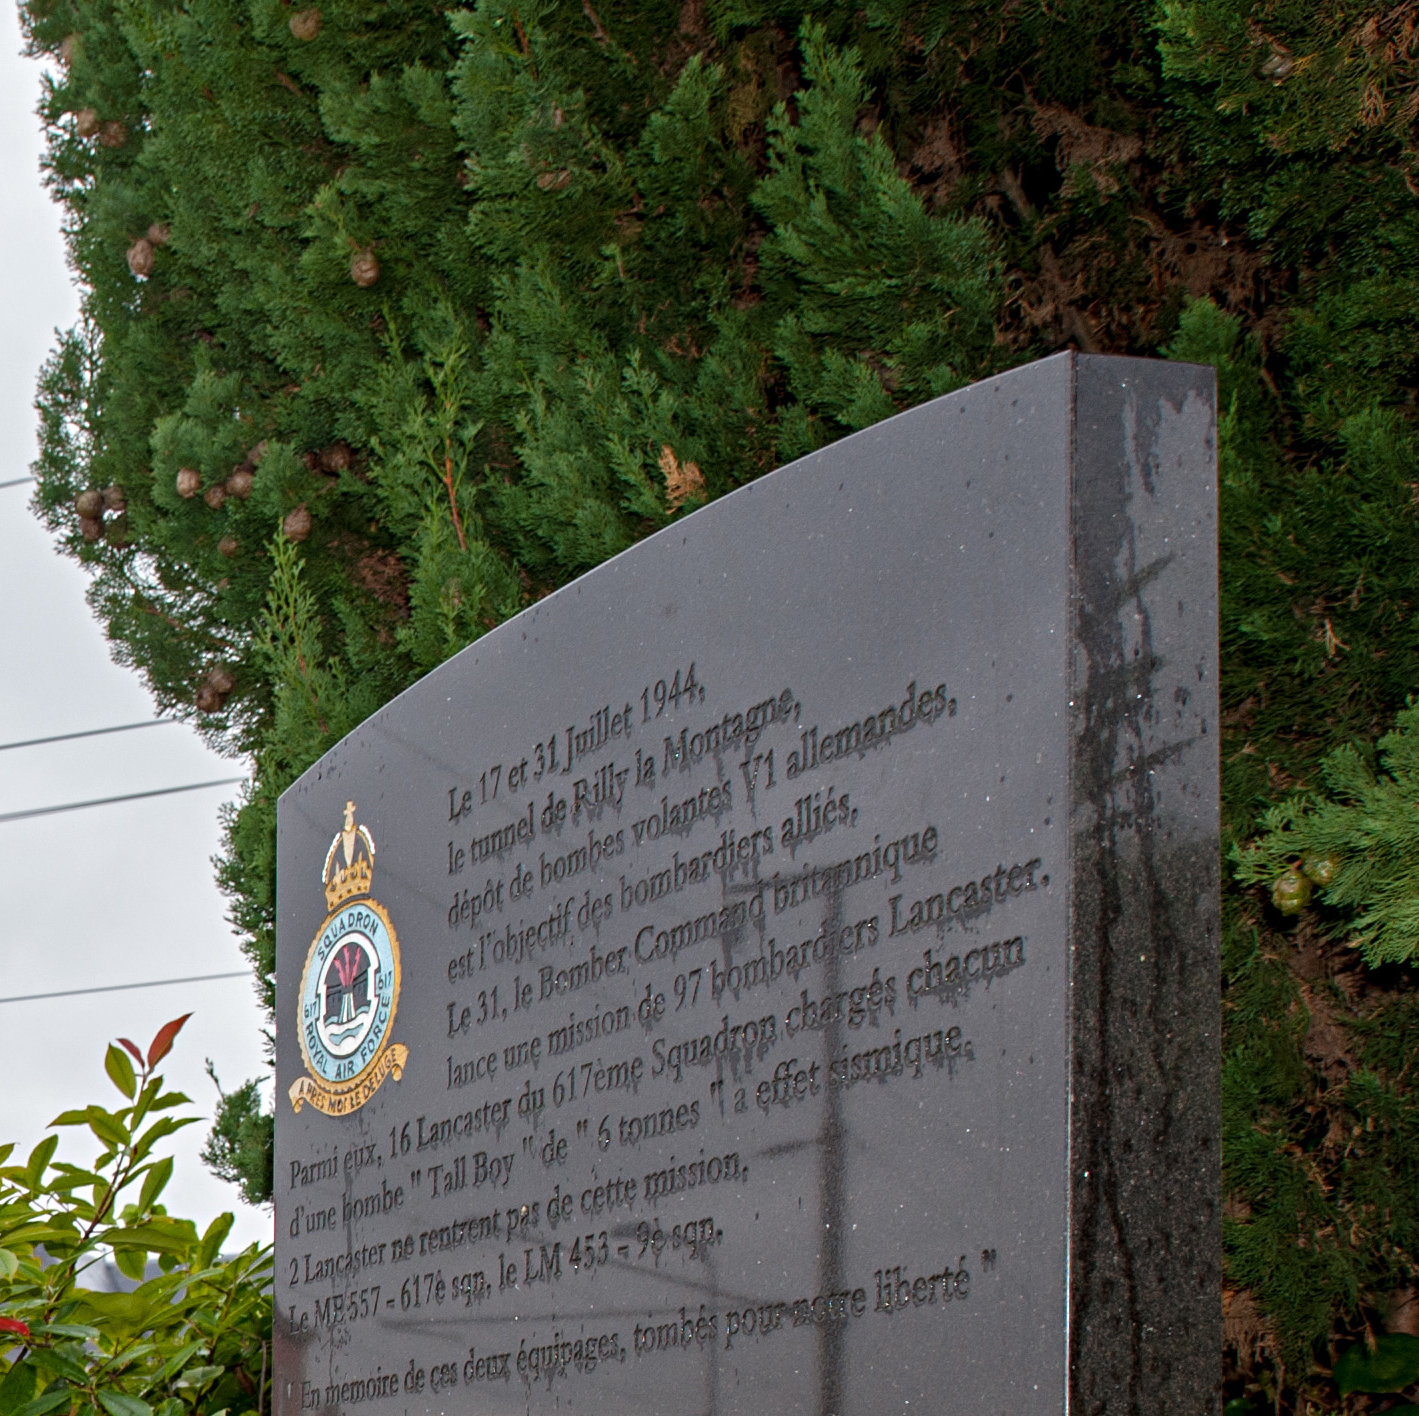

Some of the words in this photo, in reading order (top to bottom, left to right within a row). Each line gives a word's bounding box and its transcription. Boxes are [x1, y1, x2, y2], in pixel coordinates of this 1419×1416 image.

[448, 787, 472, 822] Le
[479, 765, 503, 805] 17
[508, 757, 528, 791] et
[533, 733, 559, 780] 31
[562, 703, 633, 776] Juillet
[640, 661, 706, 724] 1944,
[448, 841, 465, 875] le
[471, 802, 537, 865] tunnel
[541, 791, 567, 834] de
[573, 763, 630, 814] Rilly
[635, 748, 656, 786] la
[662, 687, 801, 774] Montagne,
[448, 878, 504, 930] dépôt
[510, 863, 534, 900] de
[539, 829, 625, 889] bombes
[631, 780, 732, 848] volantes
[739, 748, 775, 790] V1
[786, 680, 957, 780] allemandes,
[317, 912, 379, 961] SQUADRON
[447, 1001, 472, 1038] Le
[477, 984, 508, 1025] 31,
[514, 976, 533, 1011] le
[634, 881, 765, 965] Command
[774, 826, 938, 914] britannique
[448, 947, 474, 984] est
[479, 896, 575, 971] l'objectif
[577, 889, 612, 930] des
[619, 825, 773, 913] bombardiers
[781, 786, 858, 848] alliés,
[304, 1000, 317, 1019] 617
[305, 1022, 328, 1075] ROYAL
[334, 1060, 355, 1080] AIR
[361, 996, 390, 1064] FORCE
[378, 970, 393, 990] 617
[447, 1052, 497, 1090] lance
[503, 1036, 541, 1067] une
[548, 1004, 630, 1056] mission
[638, 984, 665, 1023] de
[673, 968, 703, 1013] 97
[710, 916, 880, 1002] bombardiers
[888, 857, 1050, 937] Lancaster.
[289, 1146, 338, 1190] Parmi
[344, 1142, 382, 1172] eux,
[390, 1122, 411, 1159] 16
[416, 1098, 511, 1151] Lancaster
[518, 1080, 545, 1118] du
[553, 1057, 643, 1107] 617ème
[652, 1013, 775, 1082] Squadron
[786, 967, 896, 1030] chargés
[907, 936, 1026, 998] chacun
[289, 1206, 336, 1239] d'une
[342, 1180, 404, 1223] bombe
[427, 1156, 466, 1199] Tall
[472, 1150, 515, 1187] Boy
[542, 1128, 568, 1163] de
[597, 1115, 611, 1151] 6
[619, 1100, 700, 1146] tonnes
[756, 1058, 820, 1107] effet
[289, 1258, 299, 1288] 2
[304, 1242, 386, 1284] Lancaster
[391, 1236, 413, 1260] ne
[419, 1209, 500, 1254] rentrent
[506, 1200, 539, 1241] pas
[547, 1185, 572, 1222] de
[580, 1177, 637, 1214] cette
[644, 1149, 748, 1198] mission,
[289, 1305, 308, 1335] Le
[401, 1270, 446, 1310] 617è
[452, 1268, 491, 1307] sqn,
[498, 1253, 517, 1288] le
[524, 1242, 562, 1284] LM
[569, 1231, 609, 1271] 453
[301, 1381, 320, 1409] En
[404, 1359, 425, 1391] de
[430, 1360, 458, 1389] ces
[464, 1347, 511, 1381] deux
[517, 1332, 626, 1382] équipages,
[634, 1305, 717, 1351] tombés
[726, 1303, 784, 1349] pour
[792, 1287, 866, 1322] notre
[874, 1255, 970, 1313] liberté
